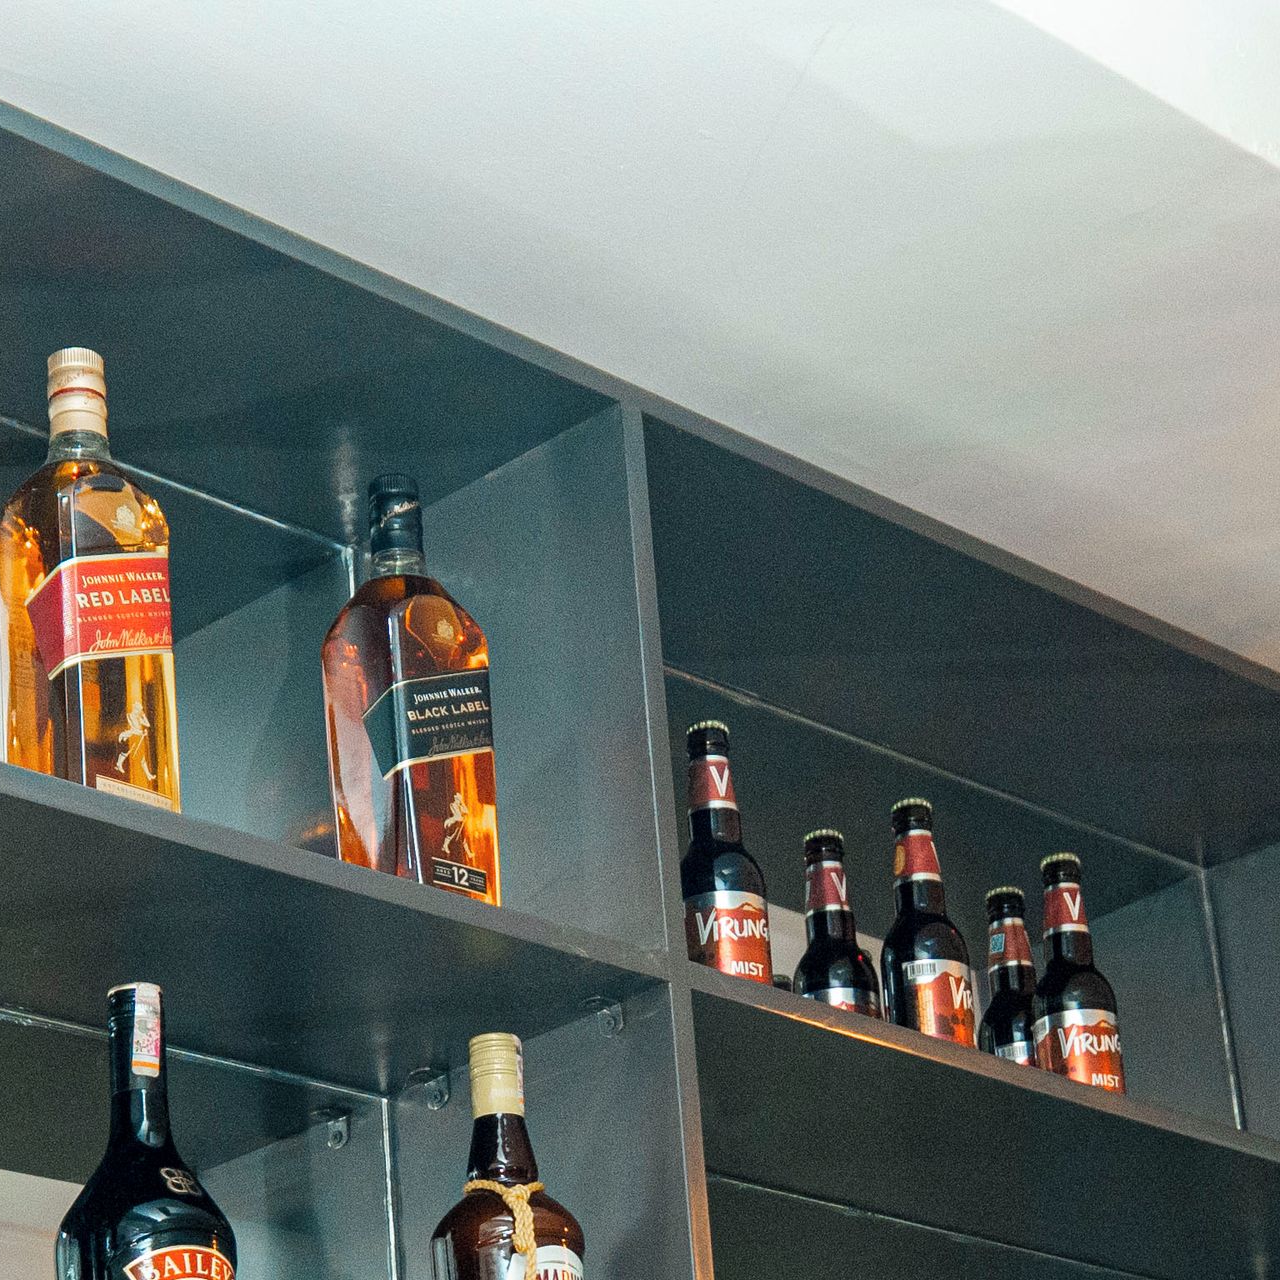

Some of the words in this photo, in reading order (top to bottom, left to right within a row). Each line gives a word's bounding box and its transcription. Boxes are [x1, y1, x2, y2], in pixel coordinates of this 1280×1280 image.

[81, 572, 126, 589] JOHNNIE
[75, 590, 115, 609] RED
[118, 587, 171, 605] LABEL
[413, 690, 449, 705] JOHNNIE
[407, 705, 449, 721] BLACK
[451, 700, 490, 715] LABEL
[709, 765, 729, 798] V
[451, 865, 469, 886] 12
[830, 872, 847, 902] V
[1063, 892, 1081, 921] V
[696, 908, 769, 946] VIRUNG
[731, 960, 764, 977] MIST
[1091, 1072, 1120, 1089] MIST
